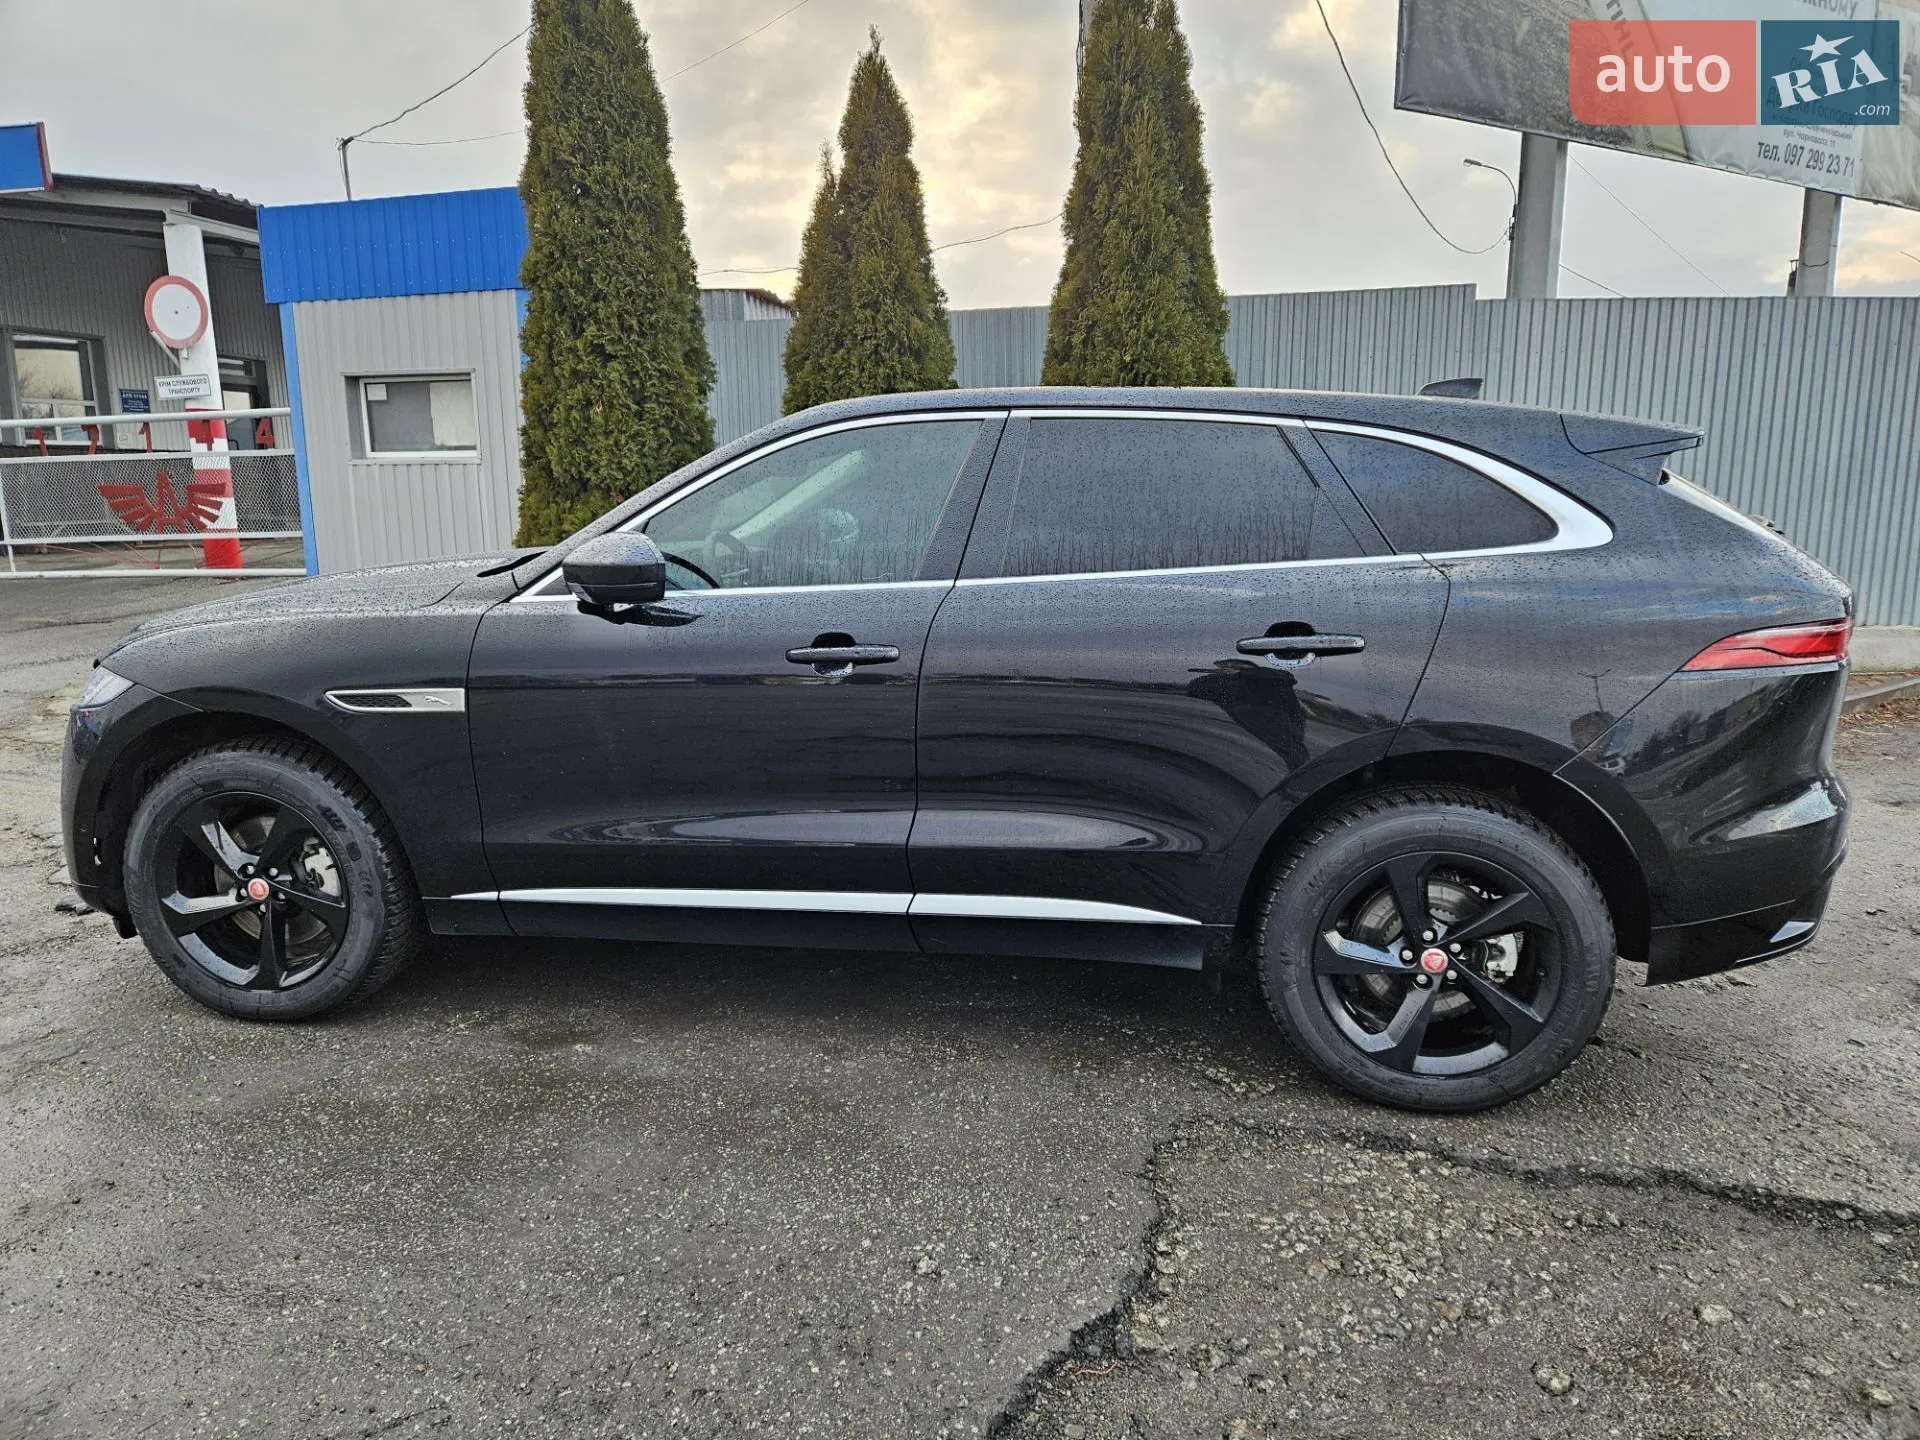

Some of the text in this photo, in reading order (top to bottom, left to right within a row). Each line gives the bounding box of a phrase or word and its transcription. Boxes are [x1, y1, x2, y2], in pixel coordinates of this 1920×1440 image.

[1757, 141, 1855, 178] тел. 097 299 23 71
[172, 377, 208, 387] СЛУЖБОВОГО
[168, 386, 201, 396] ТРАНСПОРТУ
